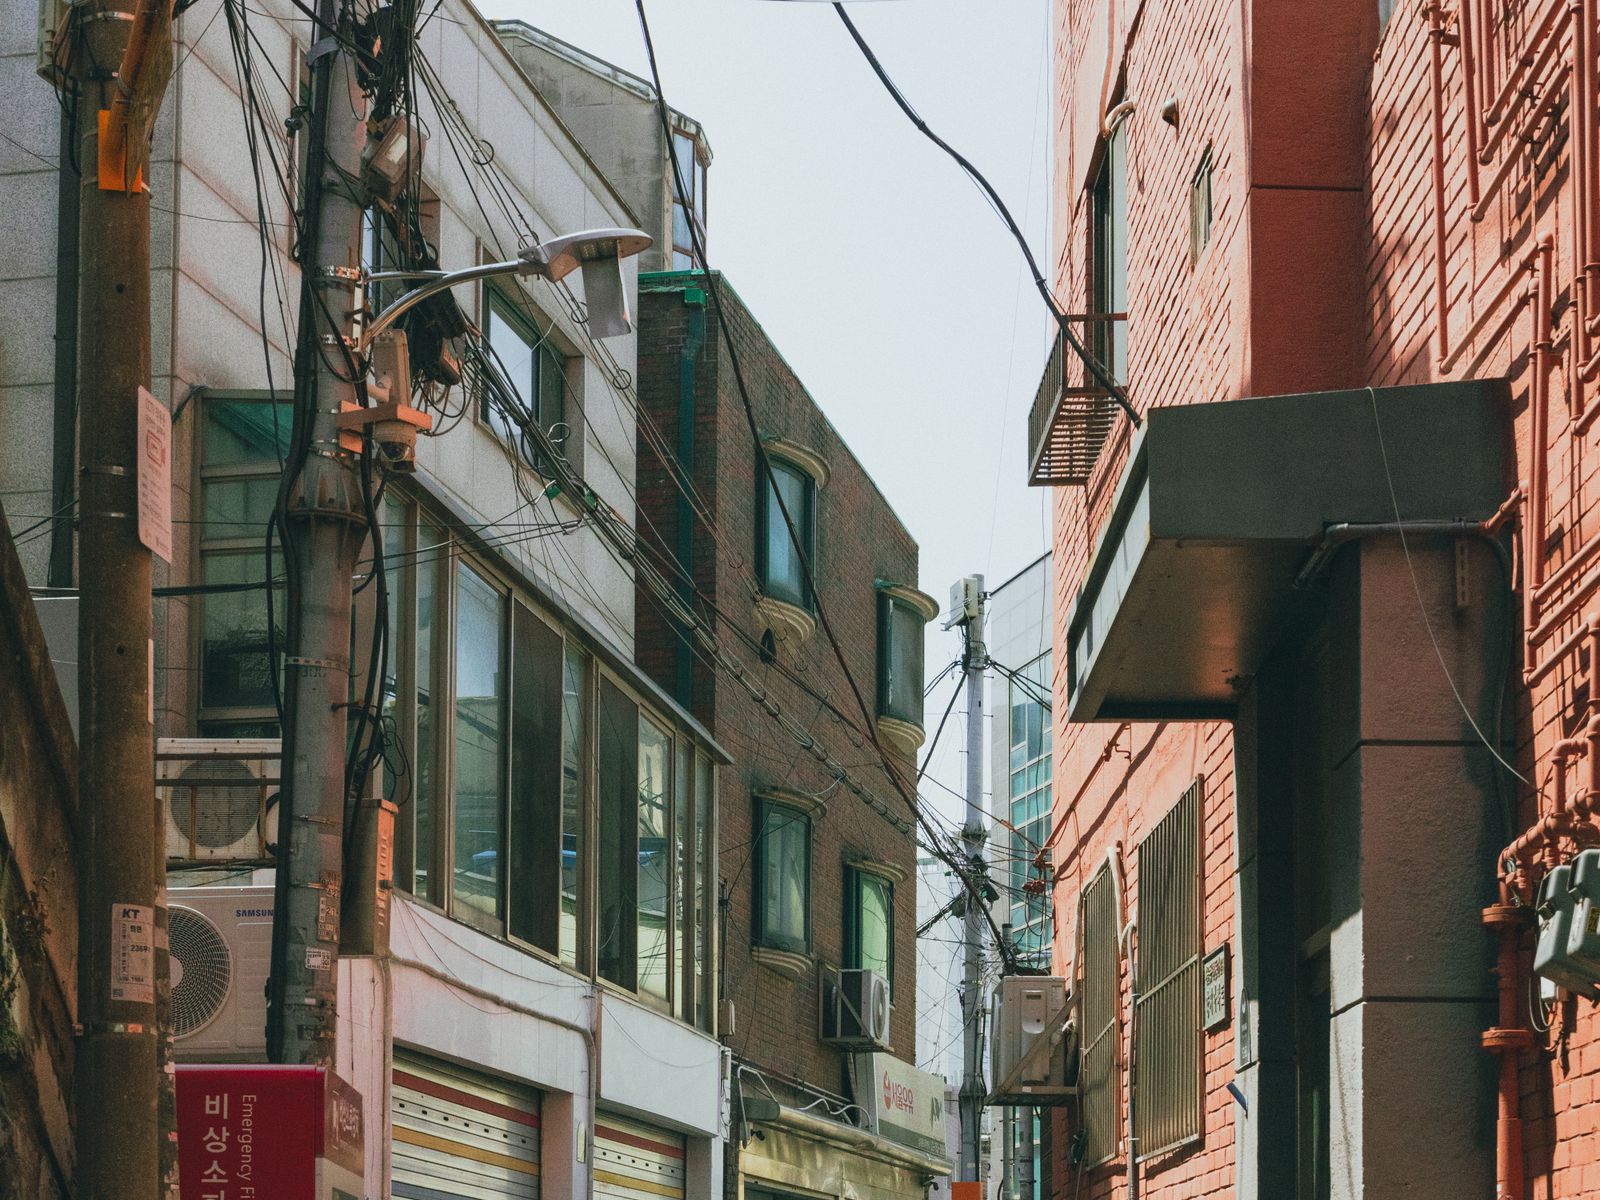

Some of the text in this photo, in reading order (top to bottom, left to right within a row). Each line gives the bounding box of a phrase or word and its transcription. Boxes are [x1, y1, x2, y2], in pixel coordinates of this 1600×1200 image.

[122, 908, 140, 919] KT
[236, 909, 274, 917] SAMSUN
[236, 1094, 257, 1181] Emergency
